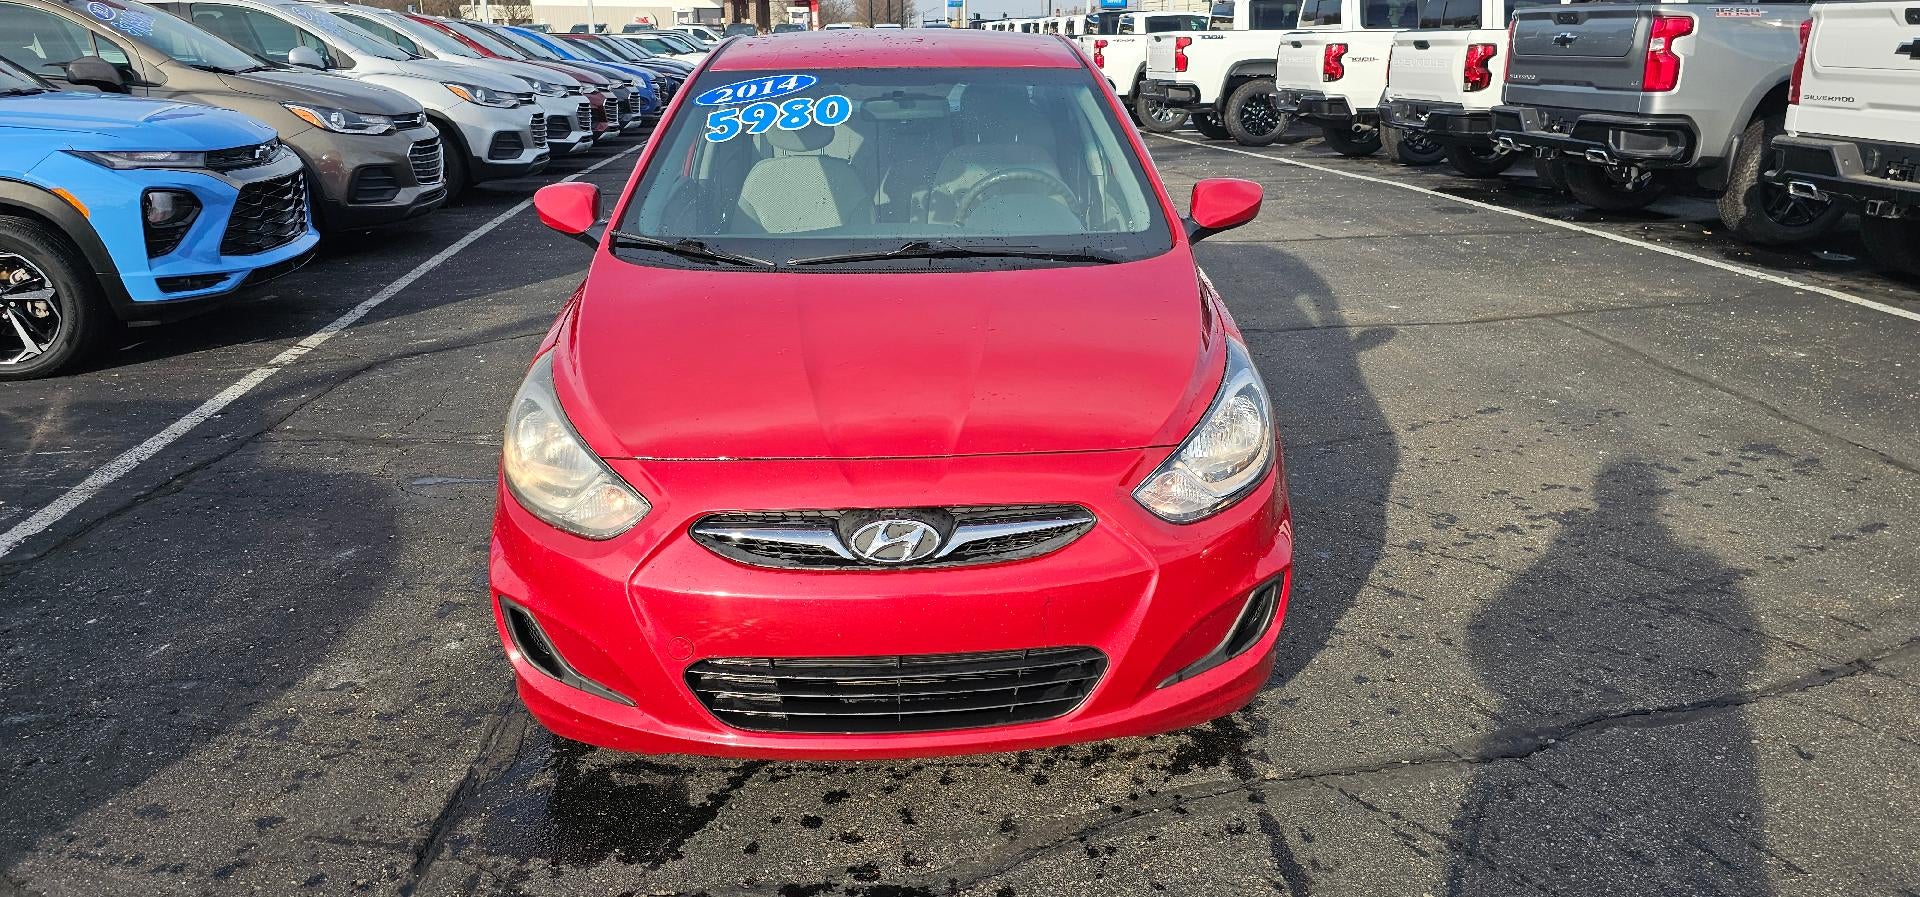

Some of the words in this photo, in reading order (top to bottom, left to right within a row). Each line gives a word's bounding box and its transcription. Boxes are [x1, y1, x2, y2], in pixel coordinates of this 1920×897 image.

[714, 75, 798, 103] 2014
[1803, 94, 1855, 103] SILVERADO
[705, 95, 852, 142] 5980
